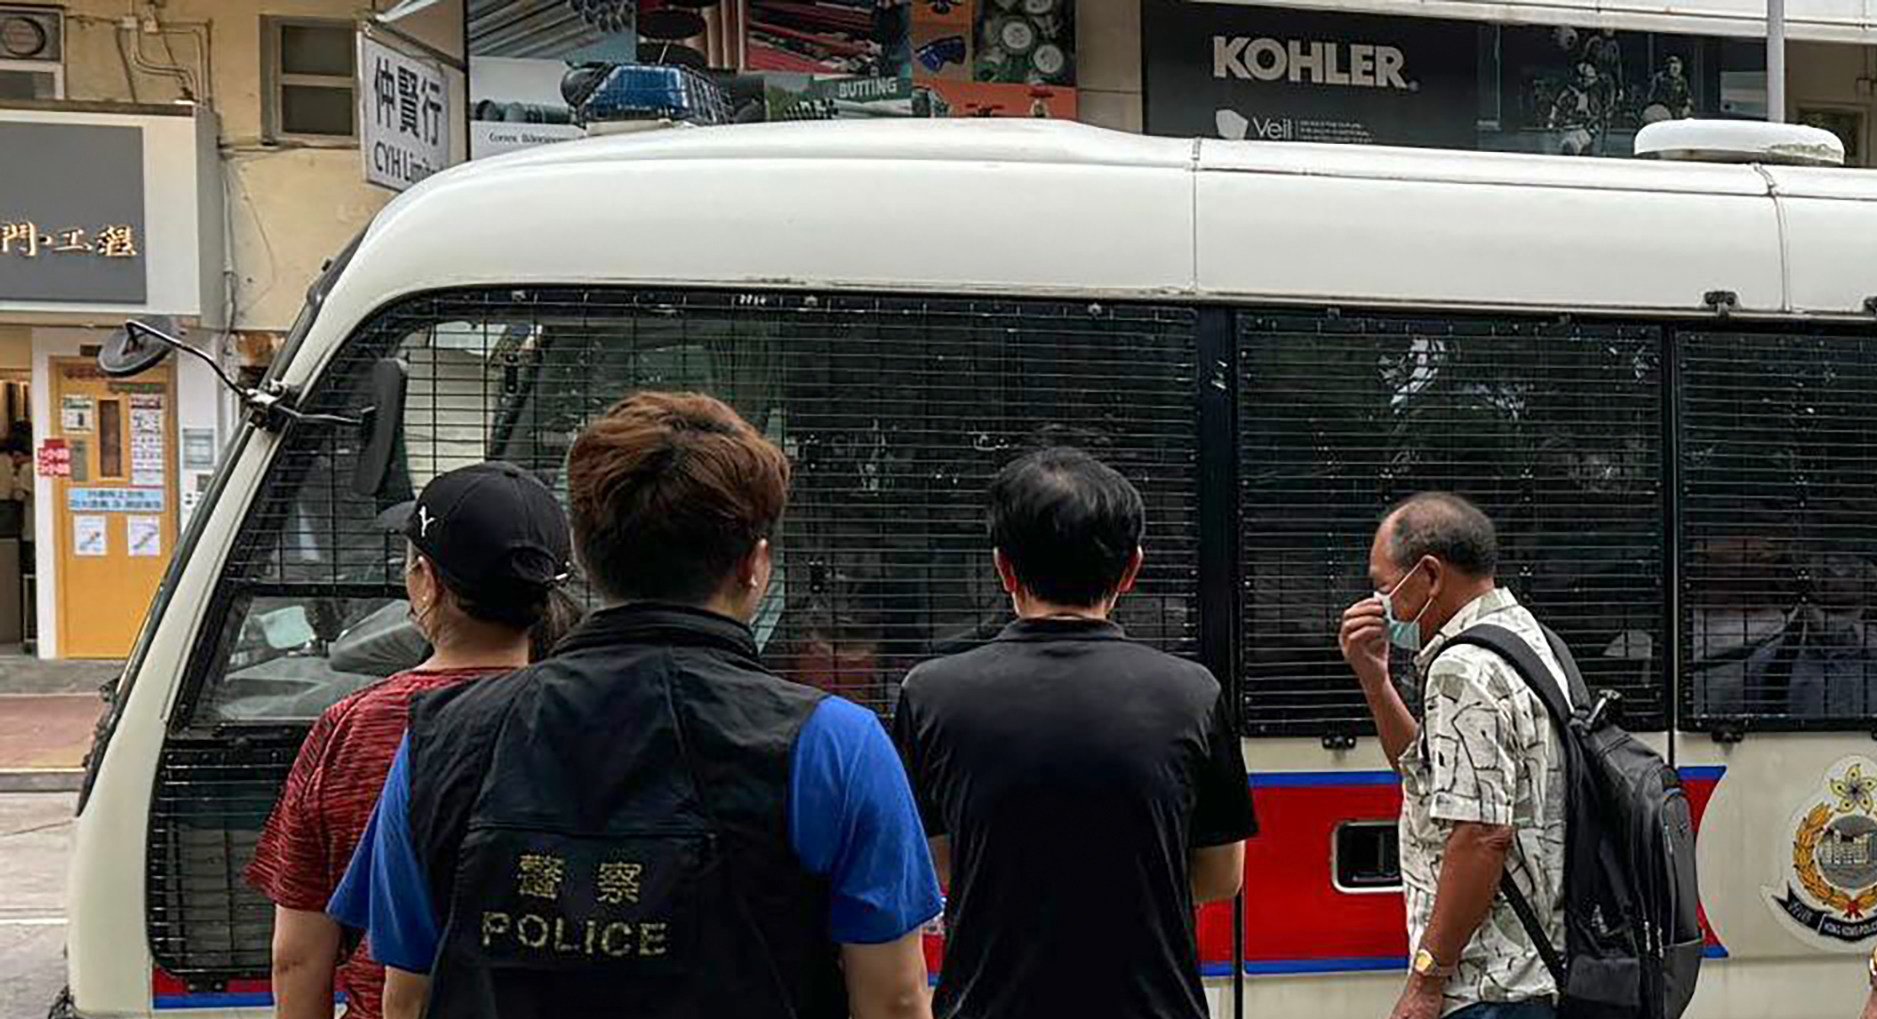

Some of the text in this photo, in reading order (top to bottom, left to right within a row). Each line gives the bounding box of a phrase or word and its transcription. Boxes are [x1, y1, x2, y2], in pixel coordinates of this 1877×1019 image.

[1213, 36, 1408, 89] KOHLER
[374, 56, 443, 146] 仲賢行
[838, 77, 898, 99] BUTTING
[1252, 116, 1293, 140] Veil
[373, 140, 402, 179] CYH
[516, 854, 643, 904] 警察
[481, 910, 668, 956] POLICE
